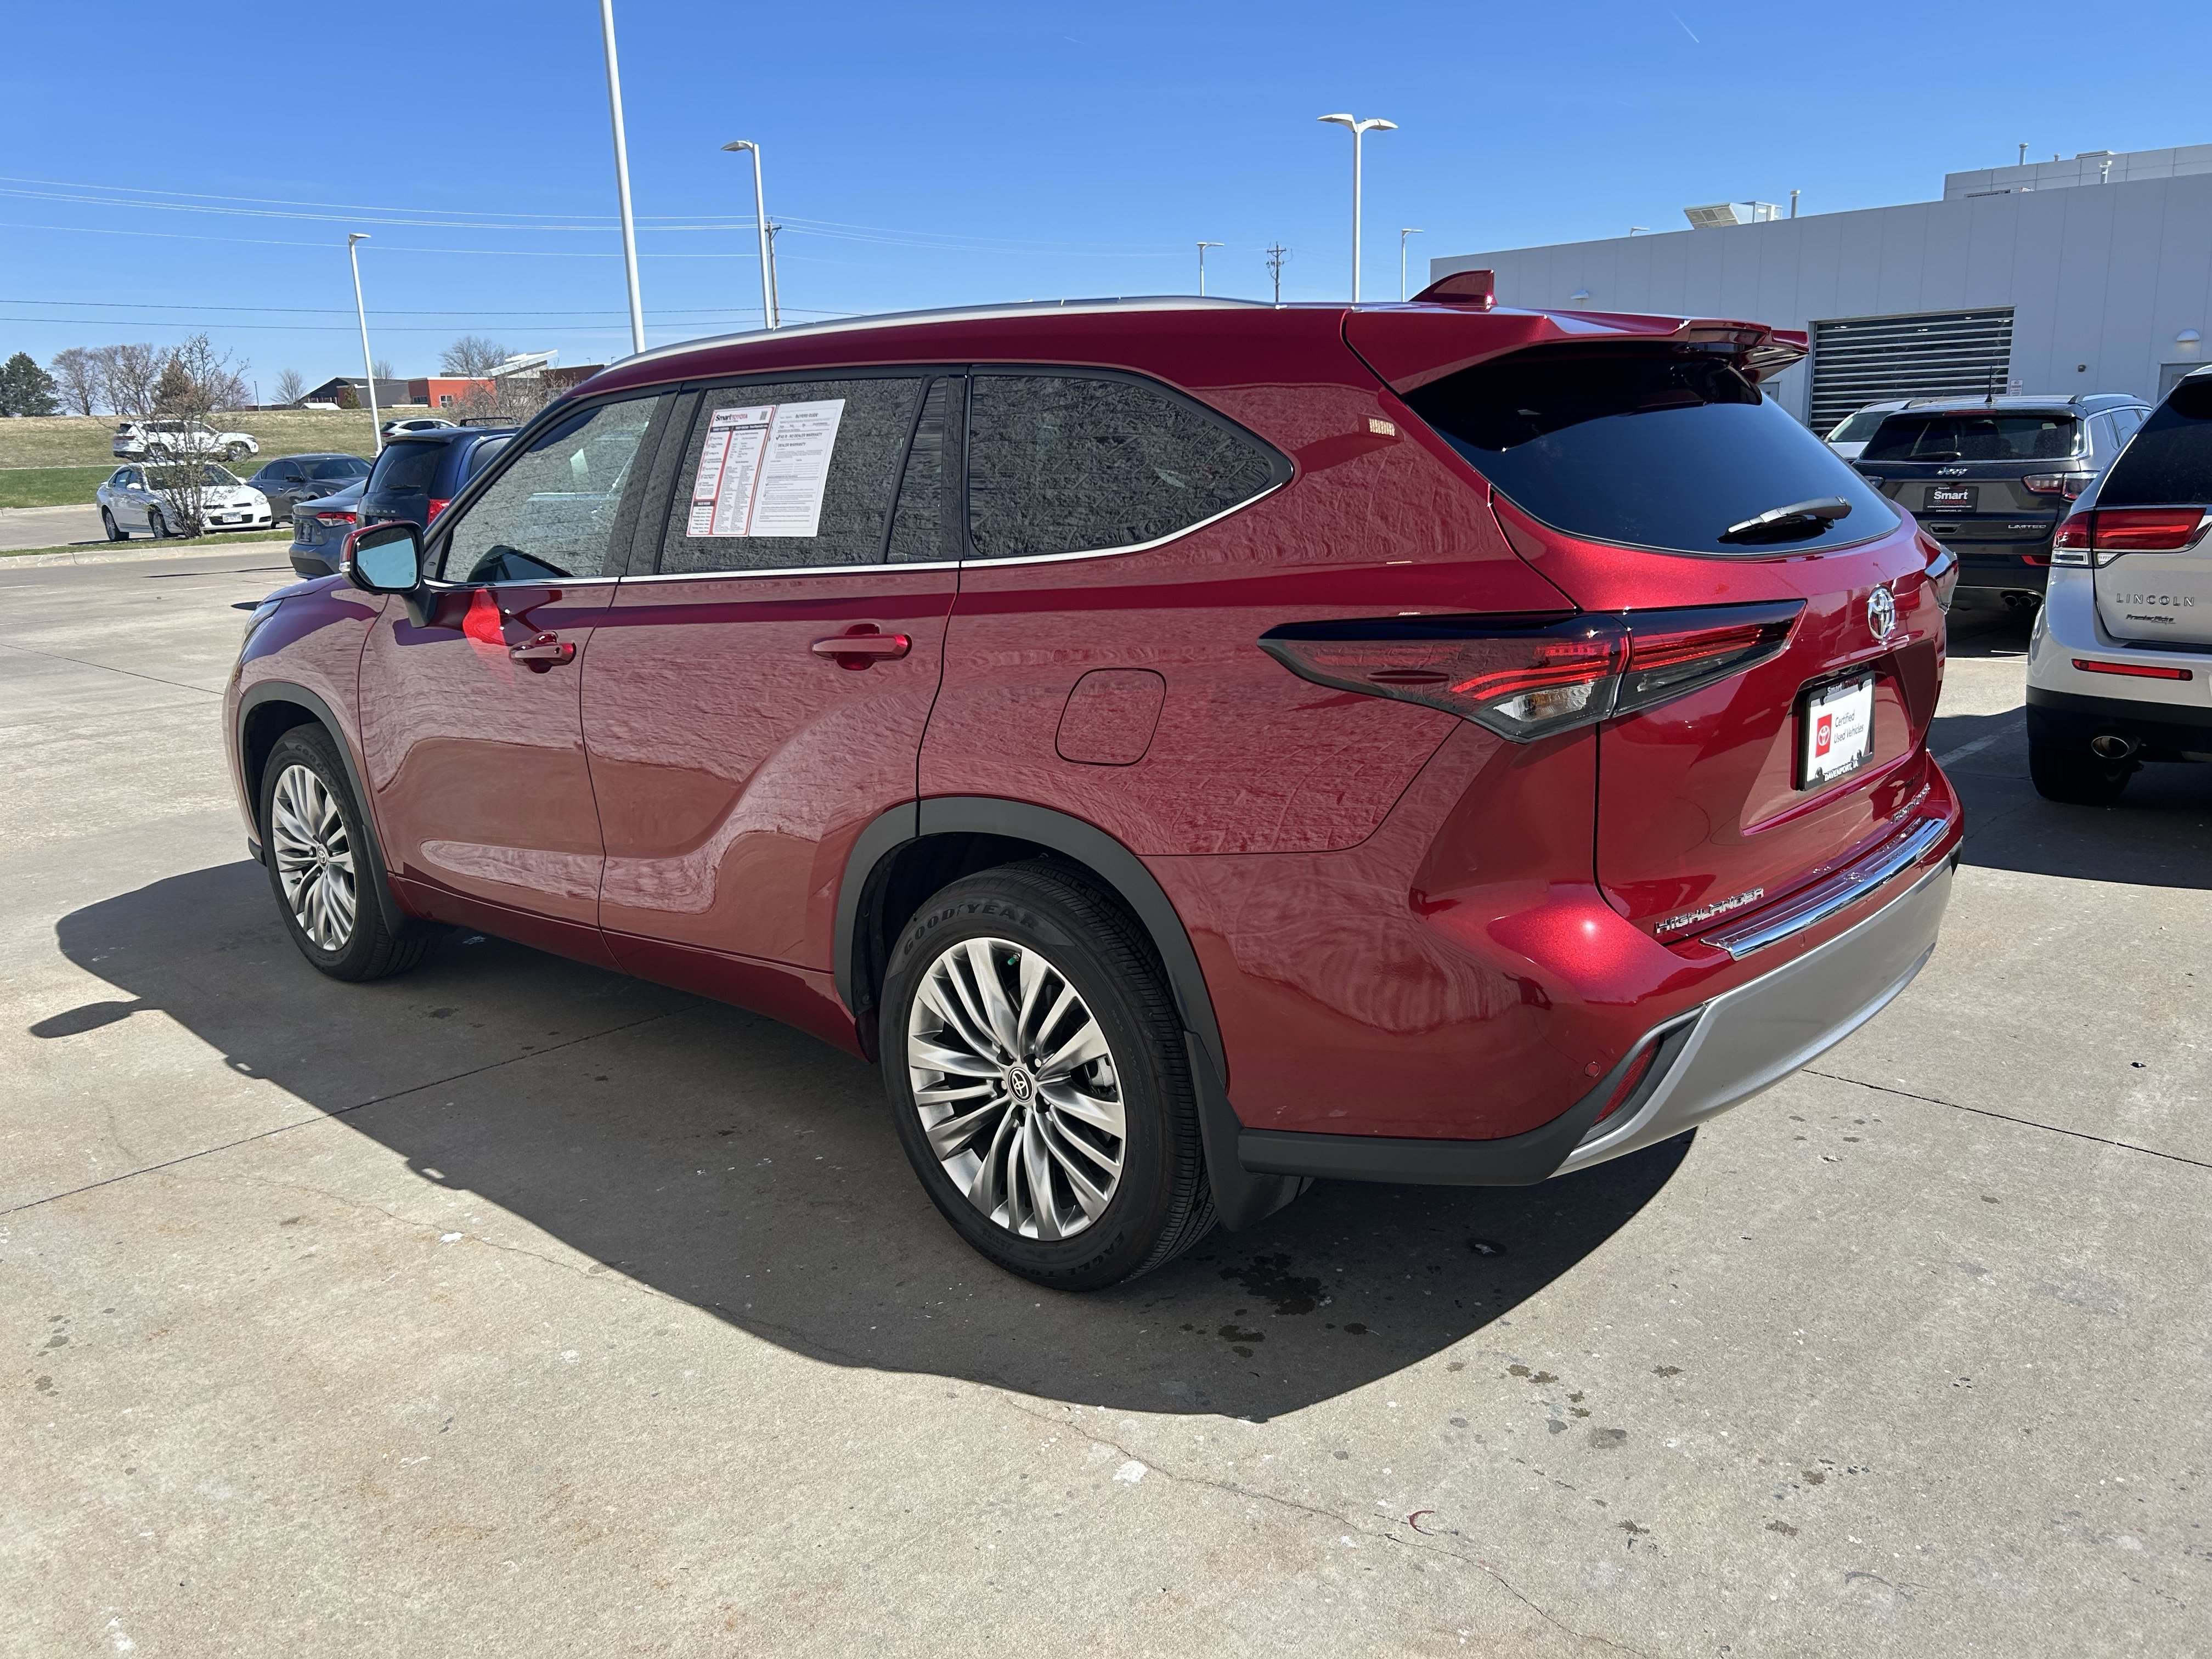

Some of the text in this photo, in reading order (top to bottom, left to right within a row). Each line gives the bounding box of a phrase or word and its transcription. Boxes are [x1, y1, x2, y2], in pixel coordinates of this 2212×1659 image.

[1933, 490, 1968, 500] Smart
[2116, 593, 2194, 607] LINCOLN
[1827, 682, 1842, 696] Smart
[1835, 709, 1855, 727] Certified
[1834, 723, 1864, 743] Used Vehicles
[1655, 887, 1764, 933] HIGHLANDER
[904, 903, 1039, 955] GOODYEAR
